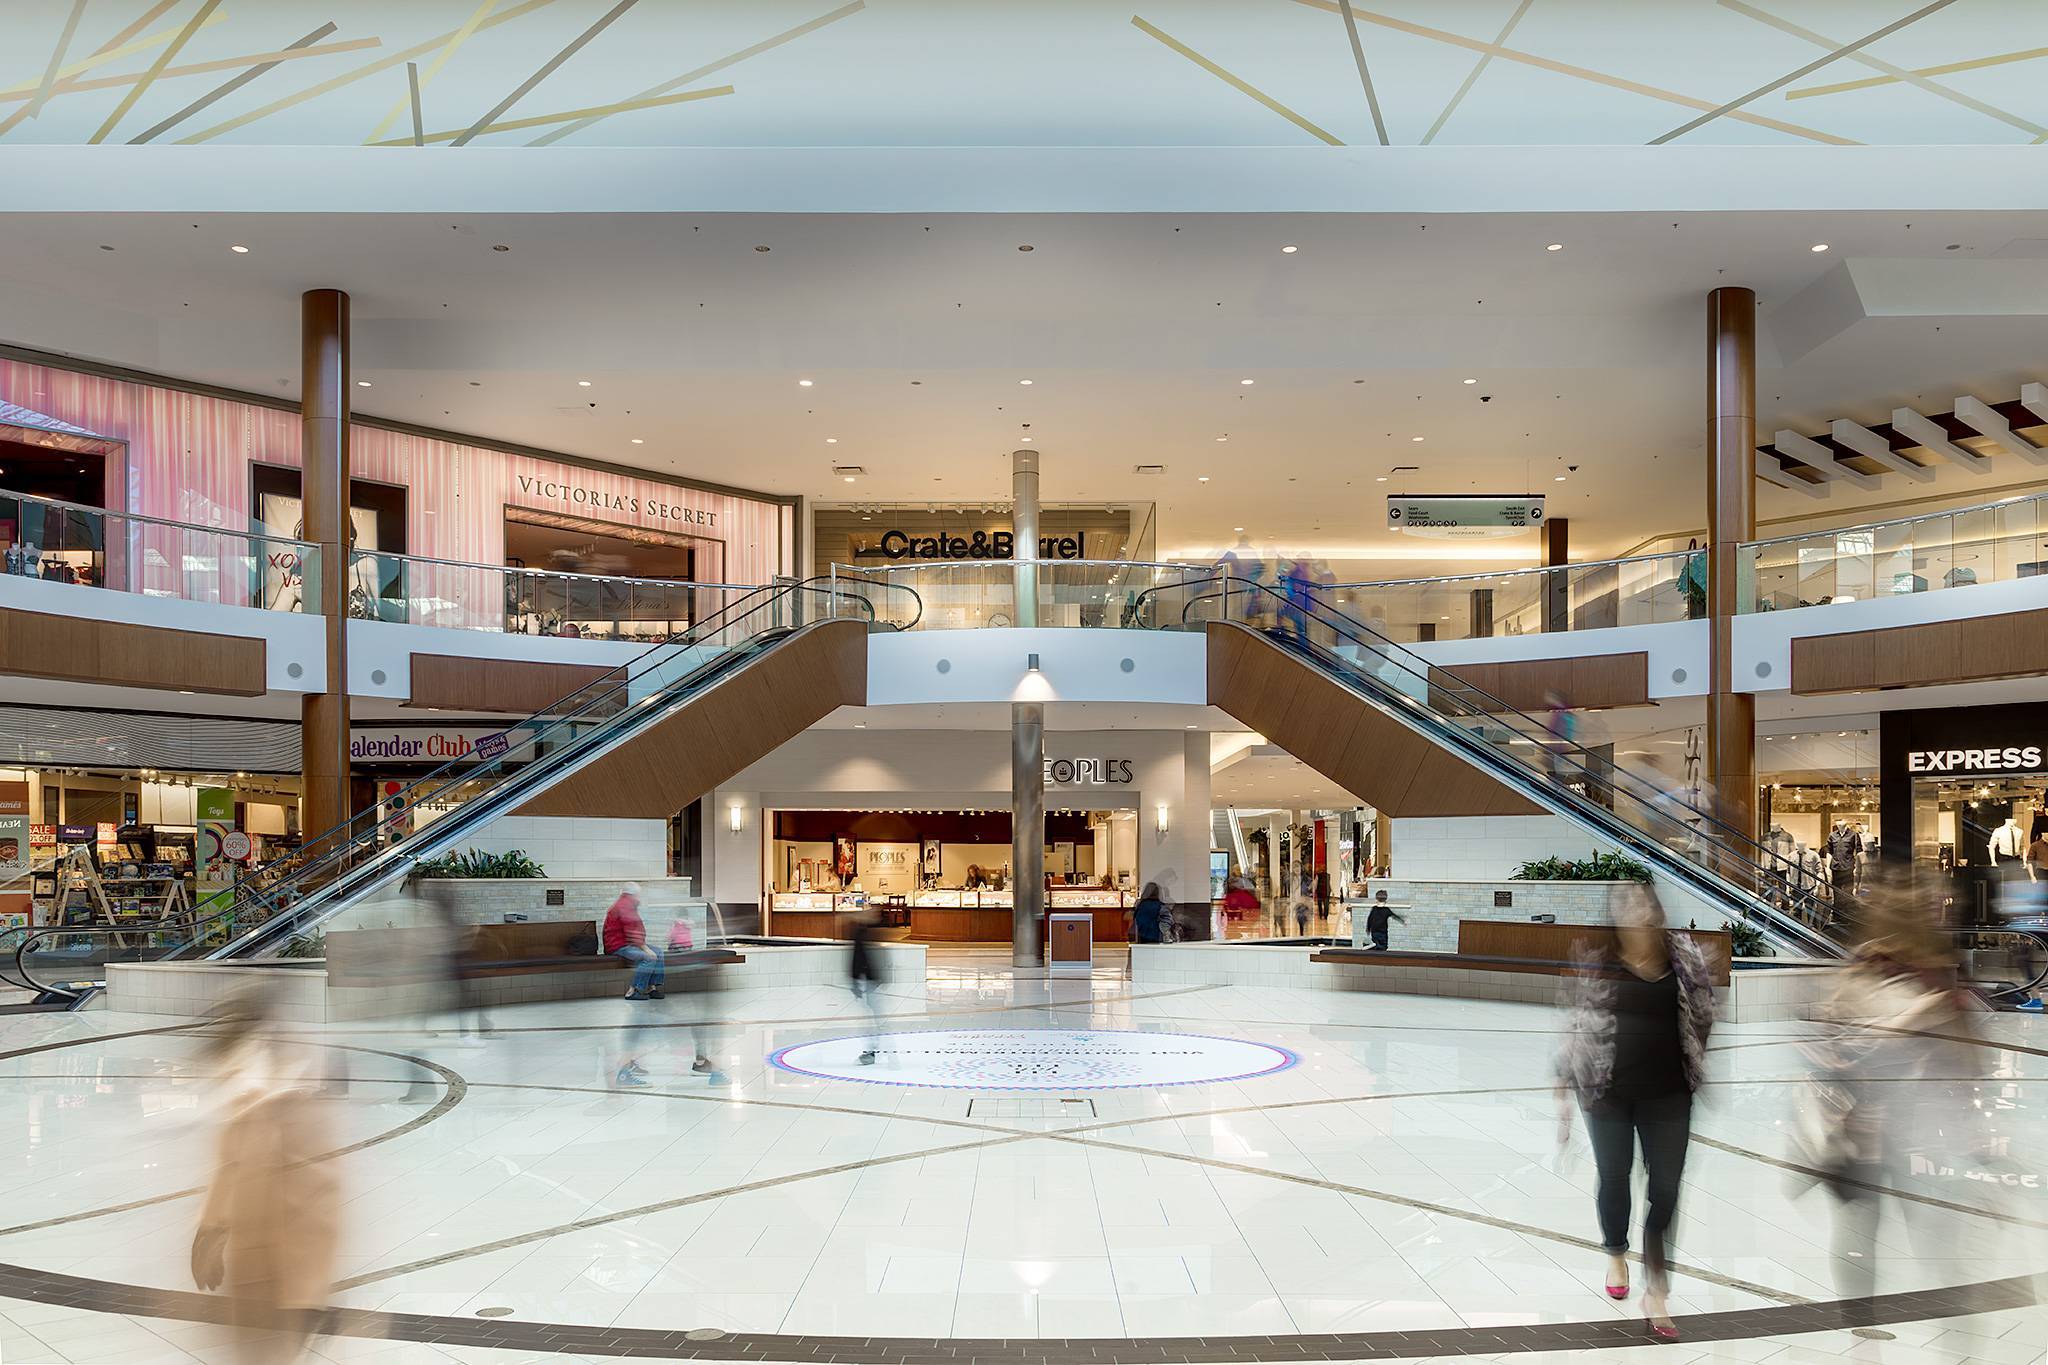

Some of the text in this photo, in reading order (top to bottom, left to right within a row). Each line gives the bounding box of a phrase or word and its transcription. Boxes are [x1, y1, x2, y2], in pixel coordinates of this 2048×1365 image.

[518, 475, 718, 527] VICTORIA'S SECRET
[880, 530, 1085, 559] Crate&Brrel
[350, 734, 423, 758] alendar
[427, 732, 472, 758] Club
[481, 742, 507, 758] games
[1908, 745, 2042, 772] EXPRESS
[1043, 759, 1133, 783] EOPLES
[0, 800, 21, 809] ames
[29, 825, 51, 834] SALE
[39, 834, 53, 842] OFF
[225, 840, 247, 849] 60%
